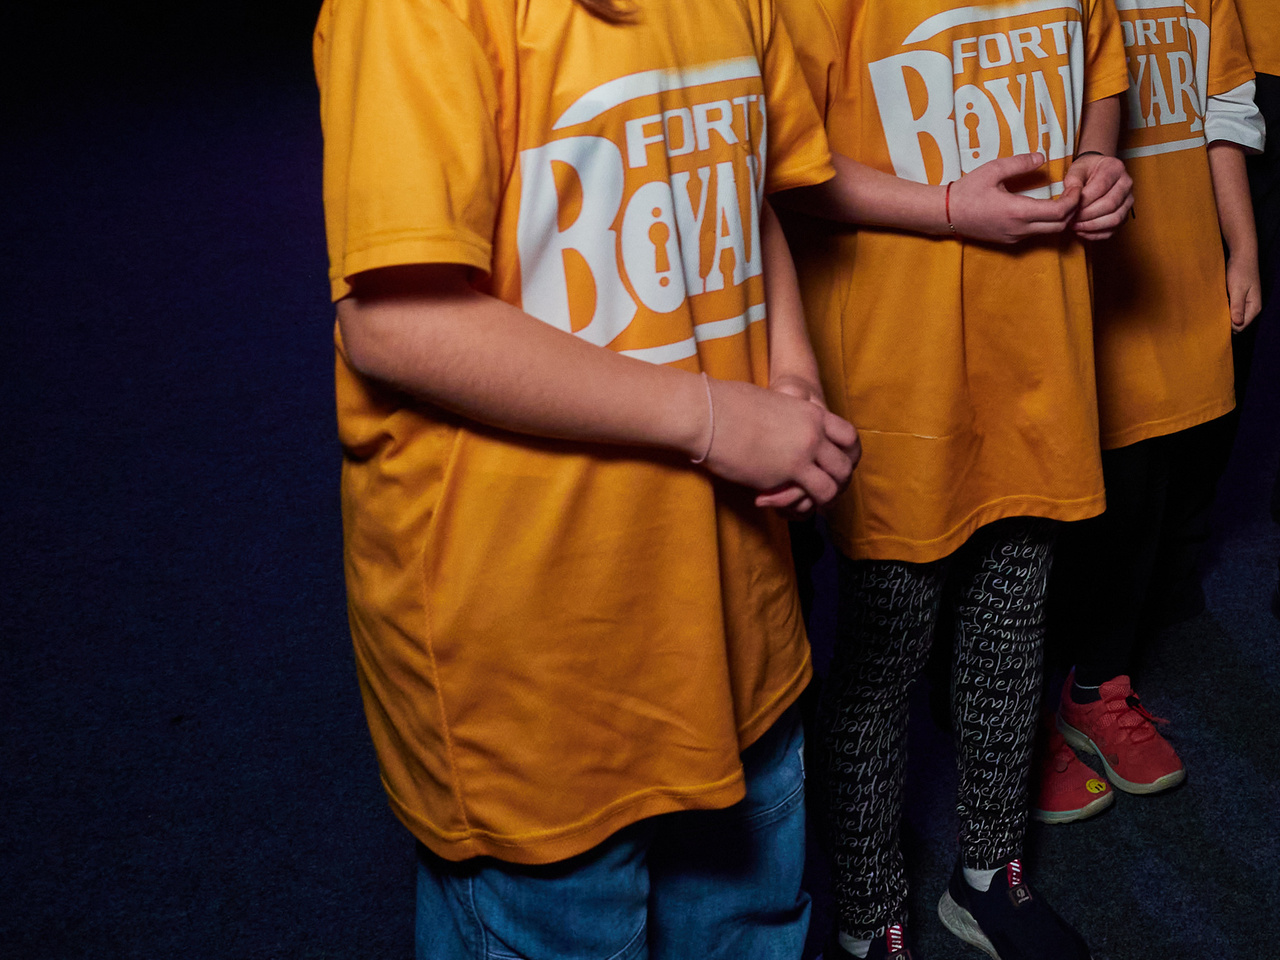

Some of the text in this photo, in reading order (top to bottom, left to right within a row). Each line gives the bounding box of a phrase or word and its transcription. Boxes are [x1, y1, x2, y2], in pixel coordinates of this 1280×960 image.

[952, 21, 1069, 75] FORT
[1120, 17, 1178, 48] ORT
[1126, 16, 1210, 133] YARD
[625, 94, 758, 168] FORT
